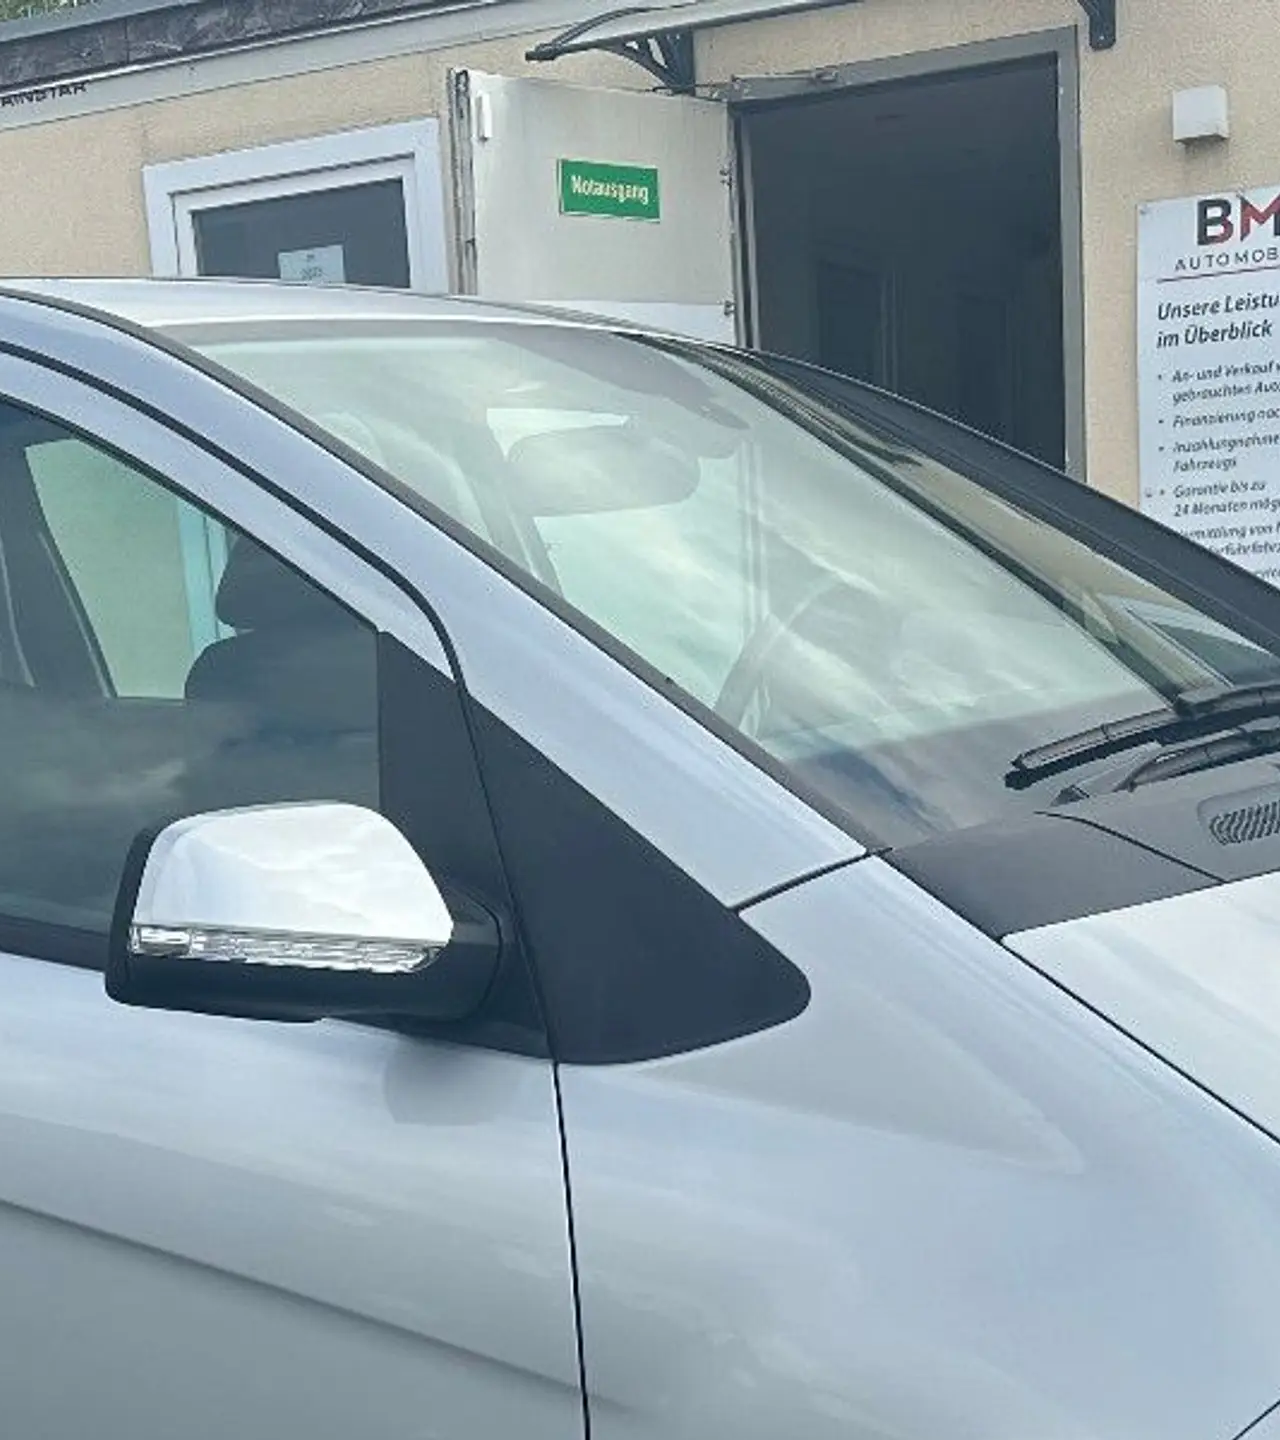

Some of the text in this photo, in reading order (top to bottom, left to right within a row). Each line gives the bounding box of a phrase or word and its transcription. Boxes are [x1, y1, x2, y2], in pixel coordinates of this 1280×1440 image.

[1157, 300, 1220, 321] Unsere
[1156, 318, 1273, 349] im Überblick
[1196, 364, 1222, 381] und
[1224, 360, 1273, 378] Verkauf
[1172, 382, 1252, 406] gebrauchten
[1172, 409, 1255, 427] Finanzierung
[1172, 456, 1237, 473] Fahrzeugs
[1174, 480, 1267, 499] Garantie bis zu
[1173, 502, 1189, 517] 24
[1191, 499, 1248, 516] Monaten
[1249, 526, 1273, 536] von
